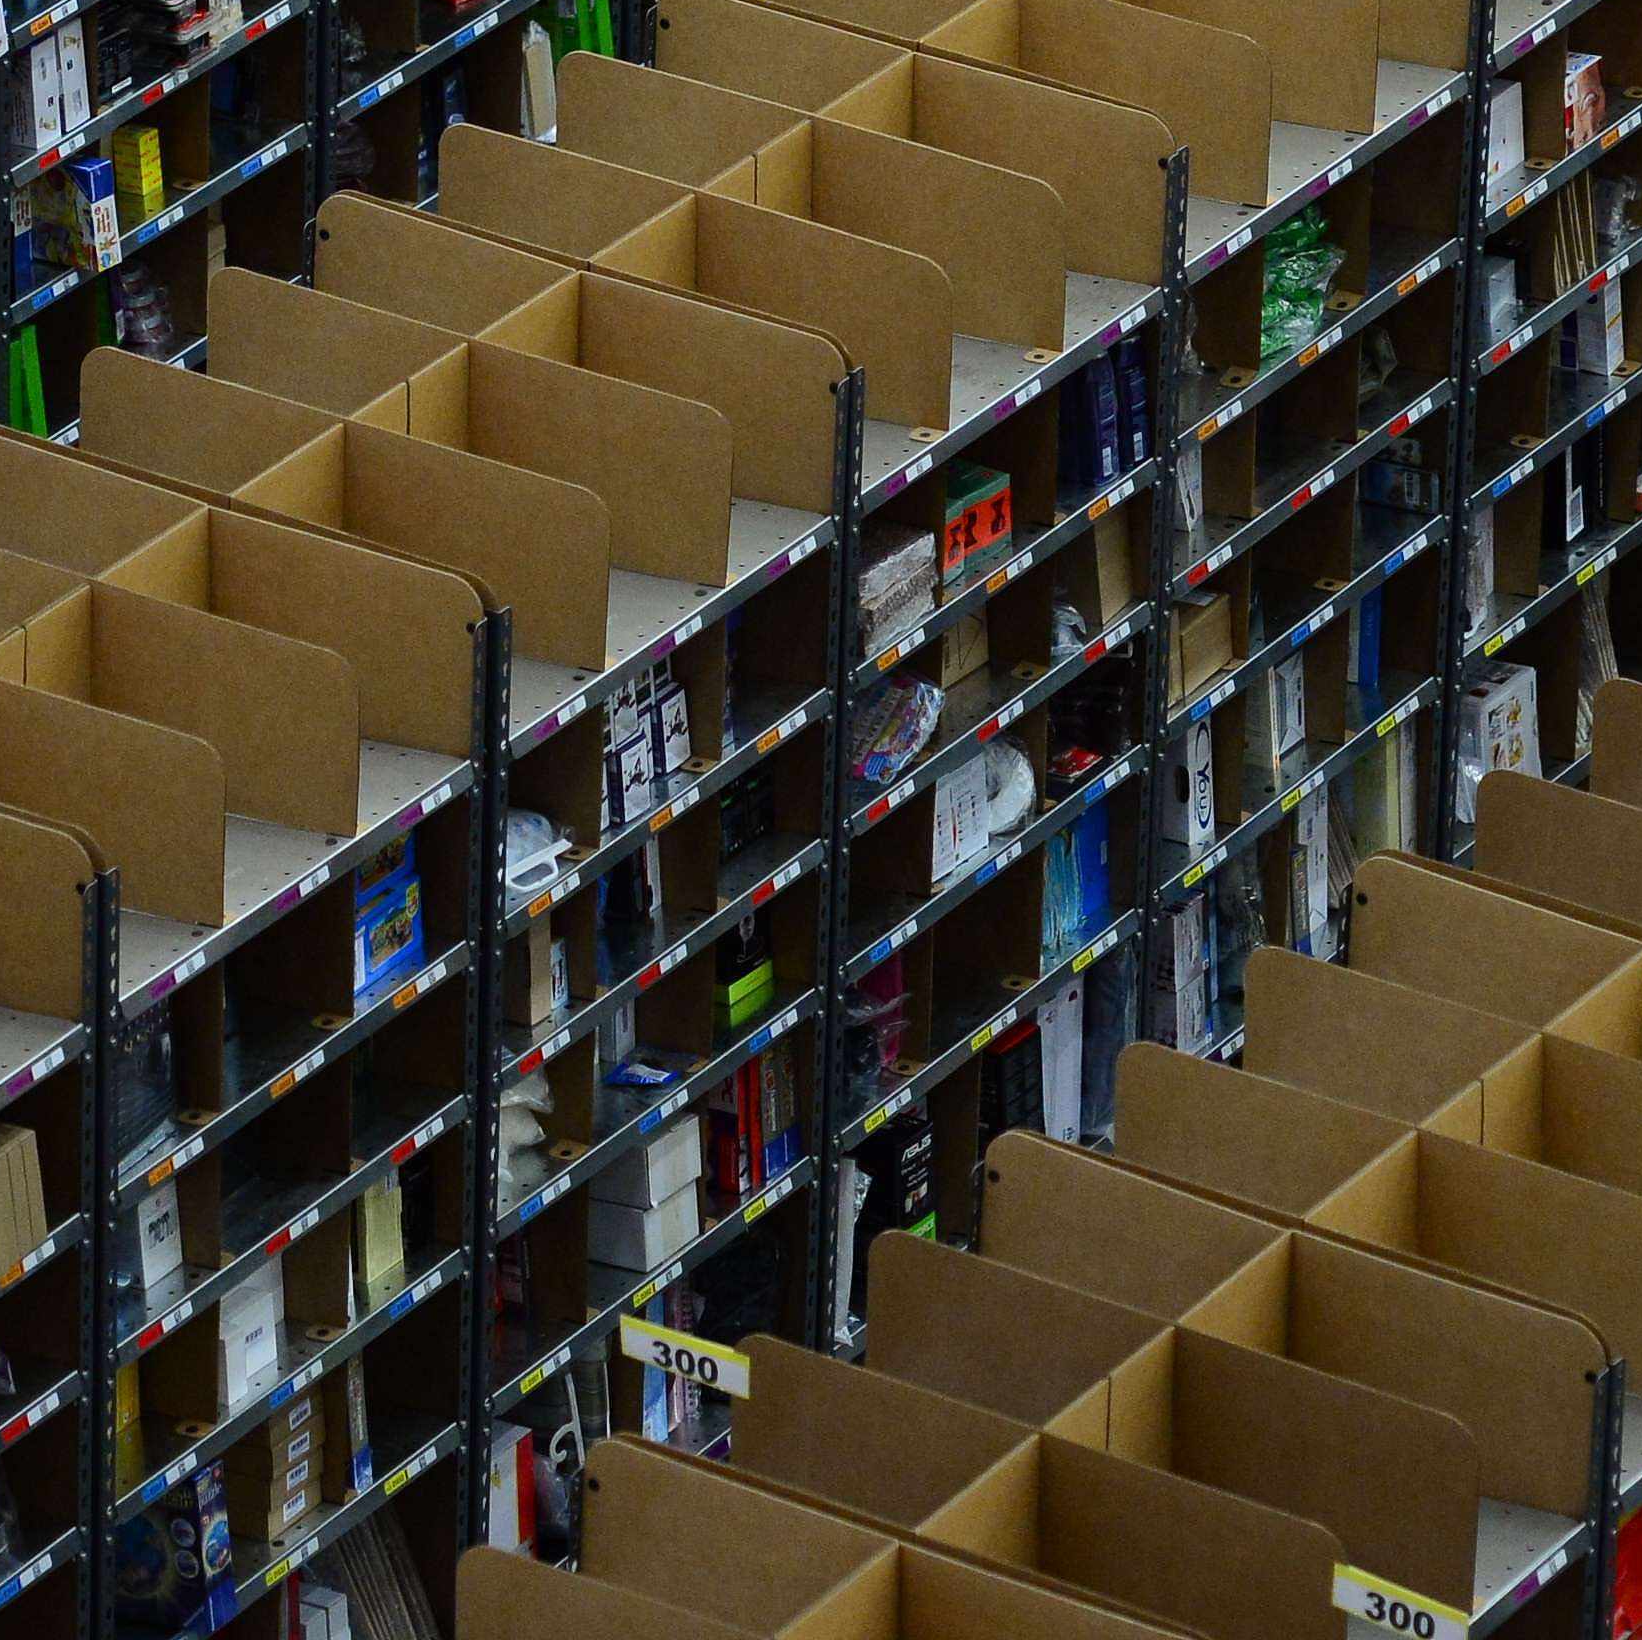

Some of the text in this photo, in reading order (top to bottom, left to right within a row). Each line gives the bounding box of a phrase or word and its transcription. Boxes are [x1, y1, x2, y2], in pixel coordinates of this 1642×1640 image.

[901, 1133, 933, 1162] ASUS
[653, 1341, 718, 1384] 300
[1366, 1592, 1434, 1639] 300
